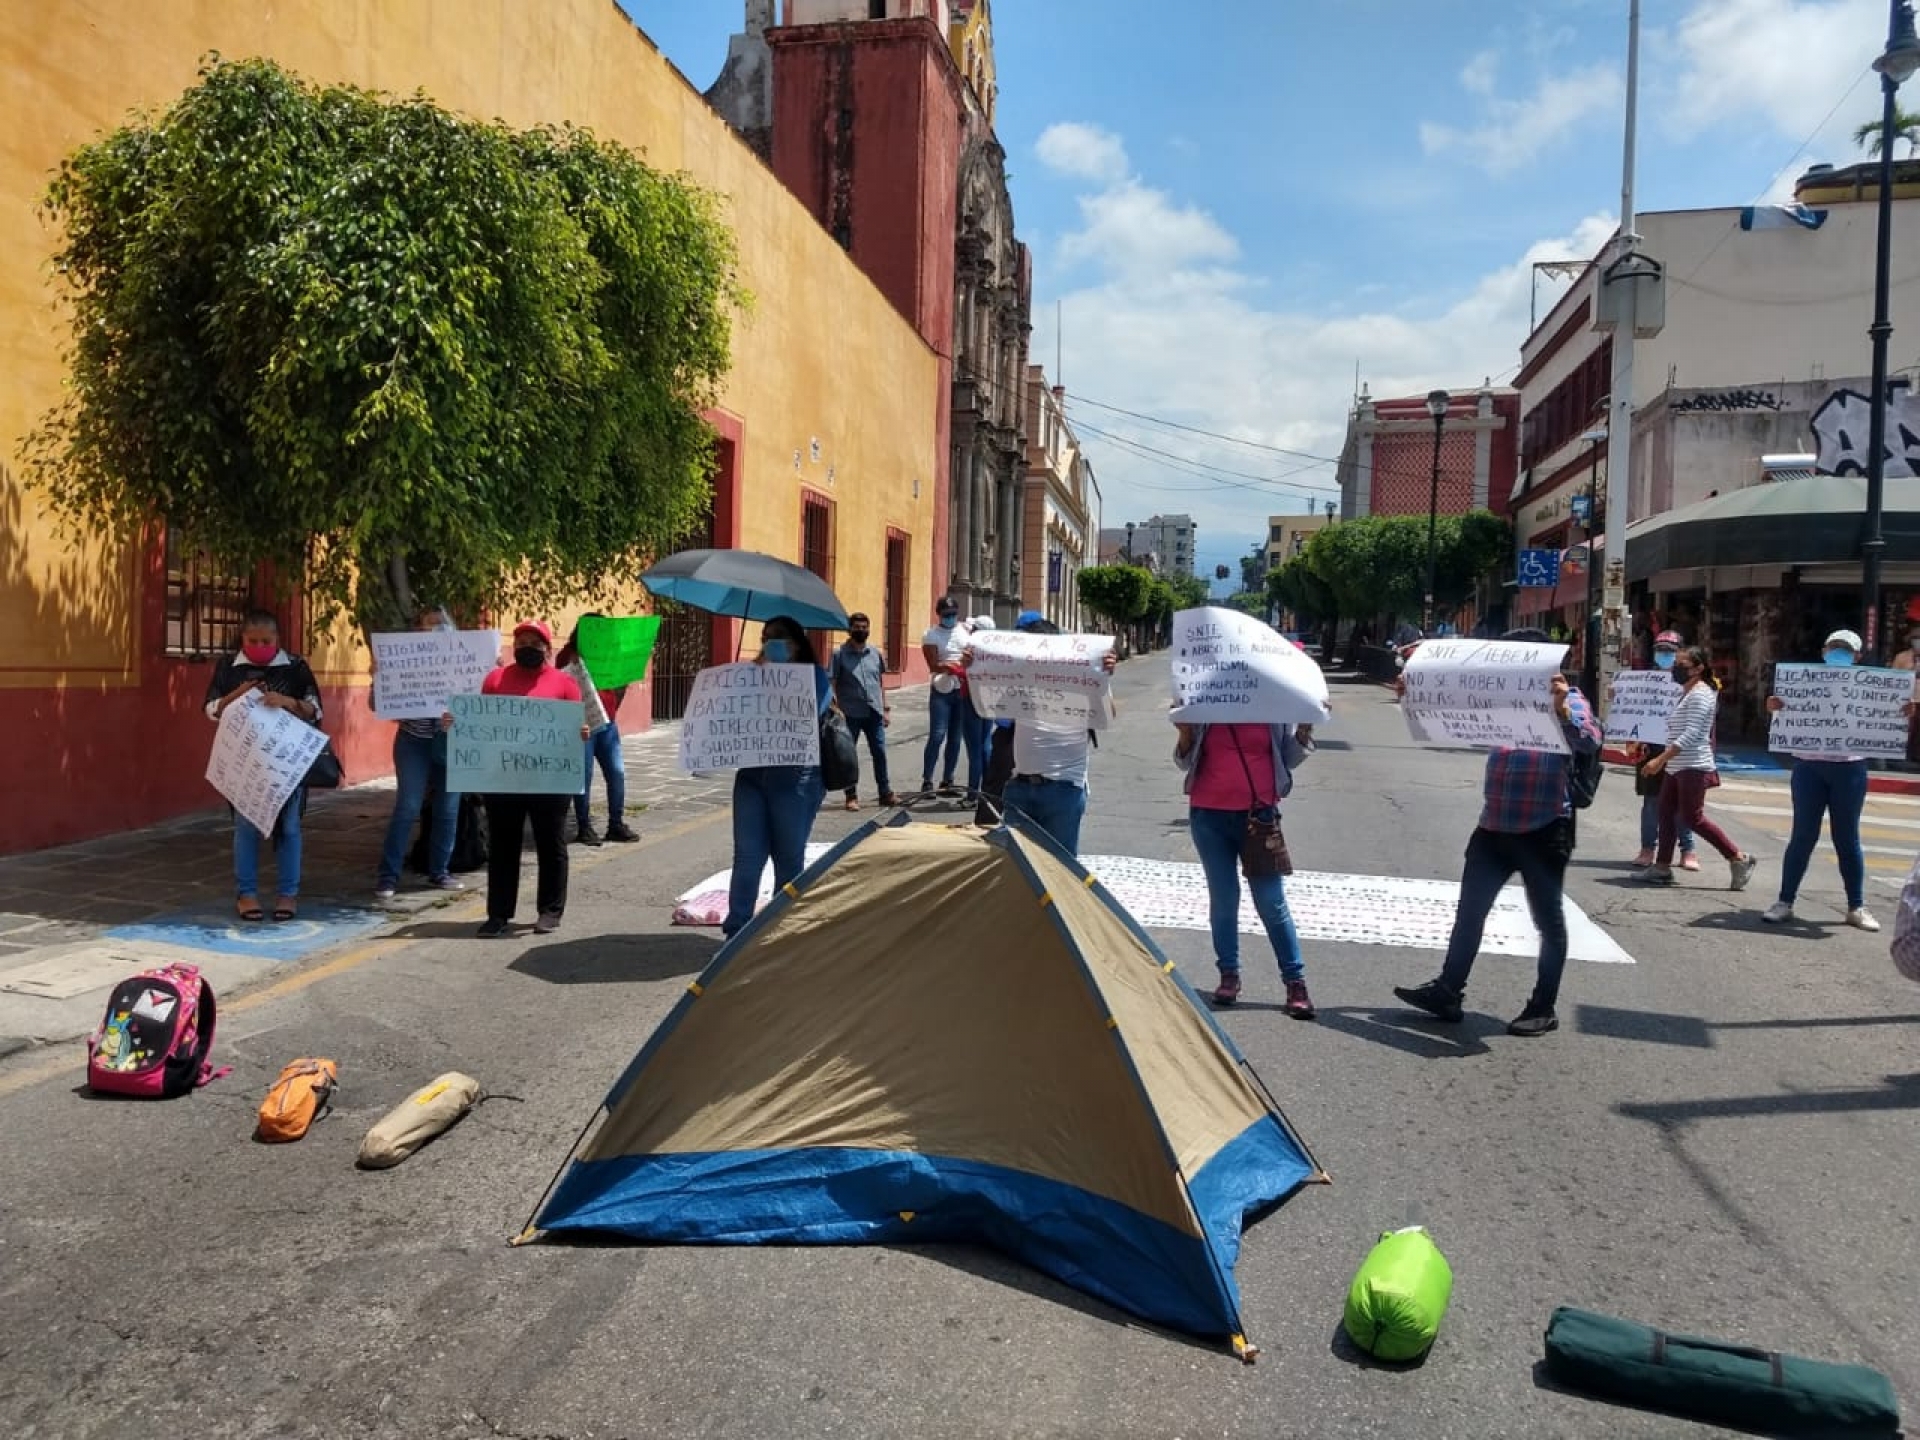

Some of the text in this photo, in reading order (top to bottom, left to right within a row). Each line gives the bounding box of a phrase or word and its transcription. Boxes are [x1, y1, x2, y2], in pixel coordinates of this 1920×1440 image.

[1187, 623, 1222, 640] SNTE
[1037, 638, 1049, 650] A
[1424, 645, 1458, 659] SNTE
[1483, 648, 1540, 663] IEBEM
[701, 667, 802, 691] EXIGIMOS
[1406, 672, 1548, 691] NO SE ROBEN LAS
[1188, 694, 1250, 706] IMPUNIDAD
[1775, 687, 1832, 698] EXIGIMOS
[1842, 687, 1858, 700] SU
[452, 695, 554, 723] QUEREMOS
[1830, 703, 1839, 715] Y
[708, 718, 814, 736] DIRECCIONES
[1772, 719, 1780, 727] A
[1786, 719, 1849, 729] NUESTRAS
[454, 723, 568, 746] RESPUESTAS
[1825, 738, 1843, 746] DE
[685, 737, 818, 755] Y SUBDIRECCIONES
[455, 749, 581, 775] NO PROMESAS
[686, 756, 704, 769] DE
